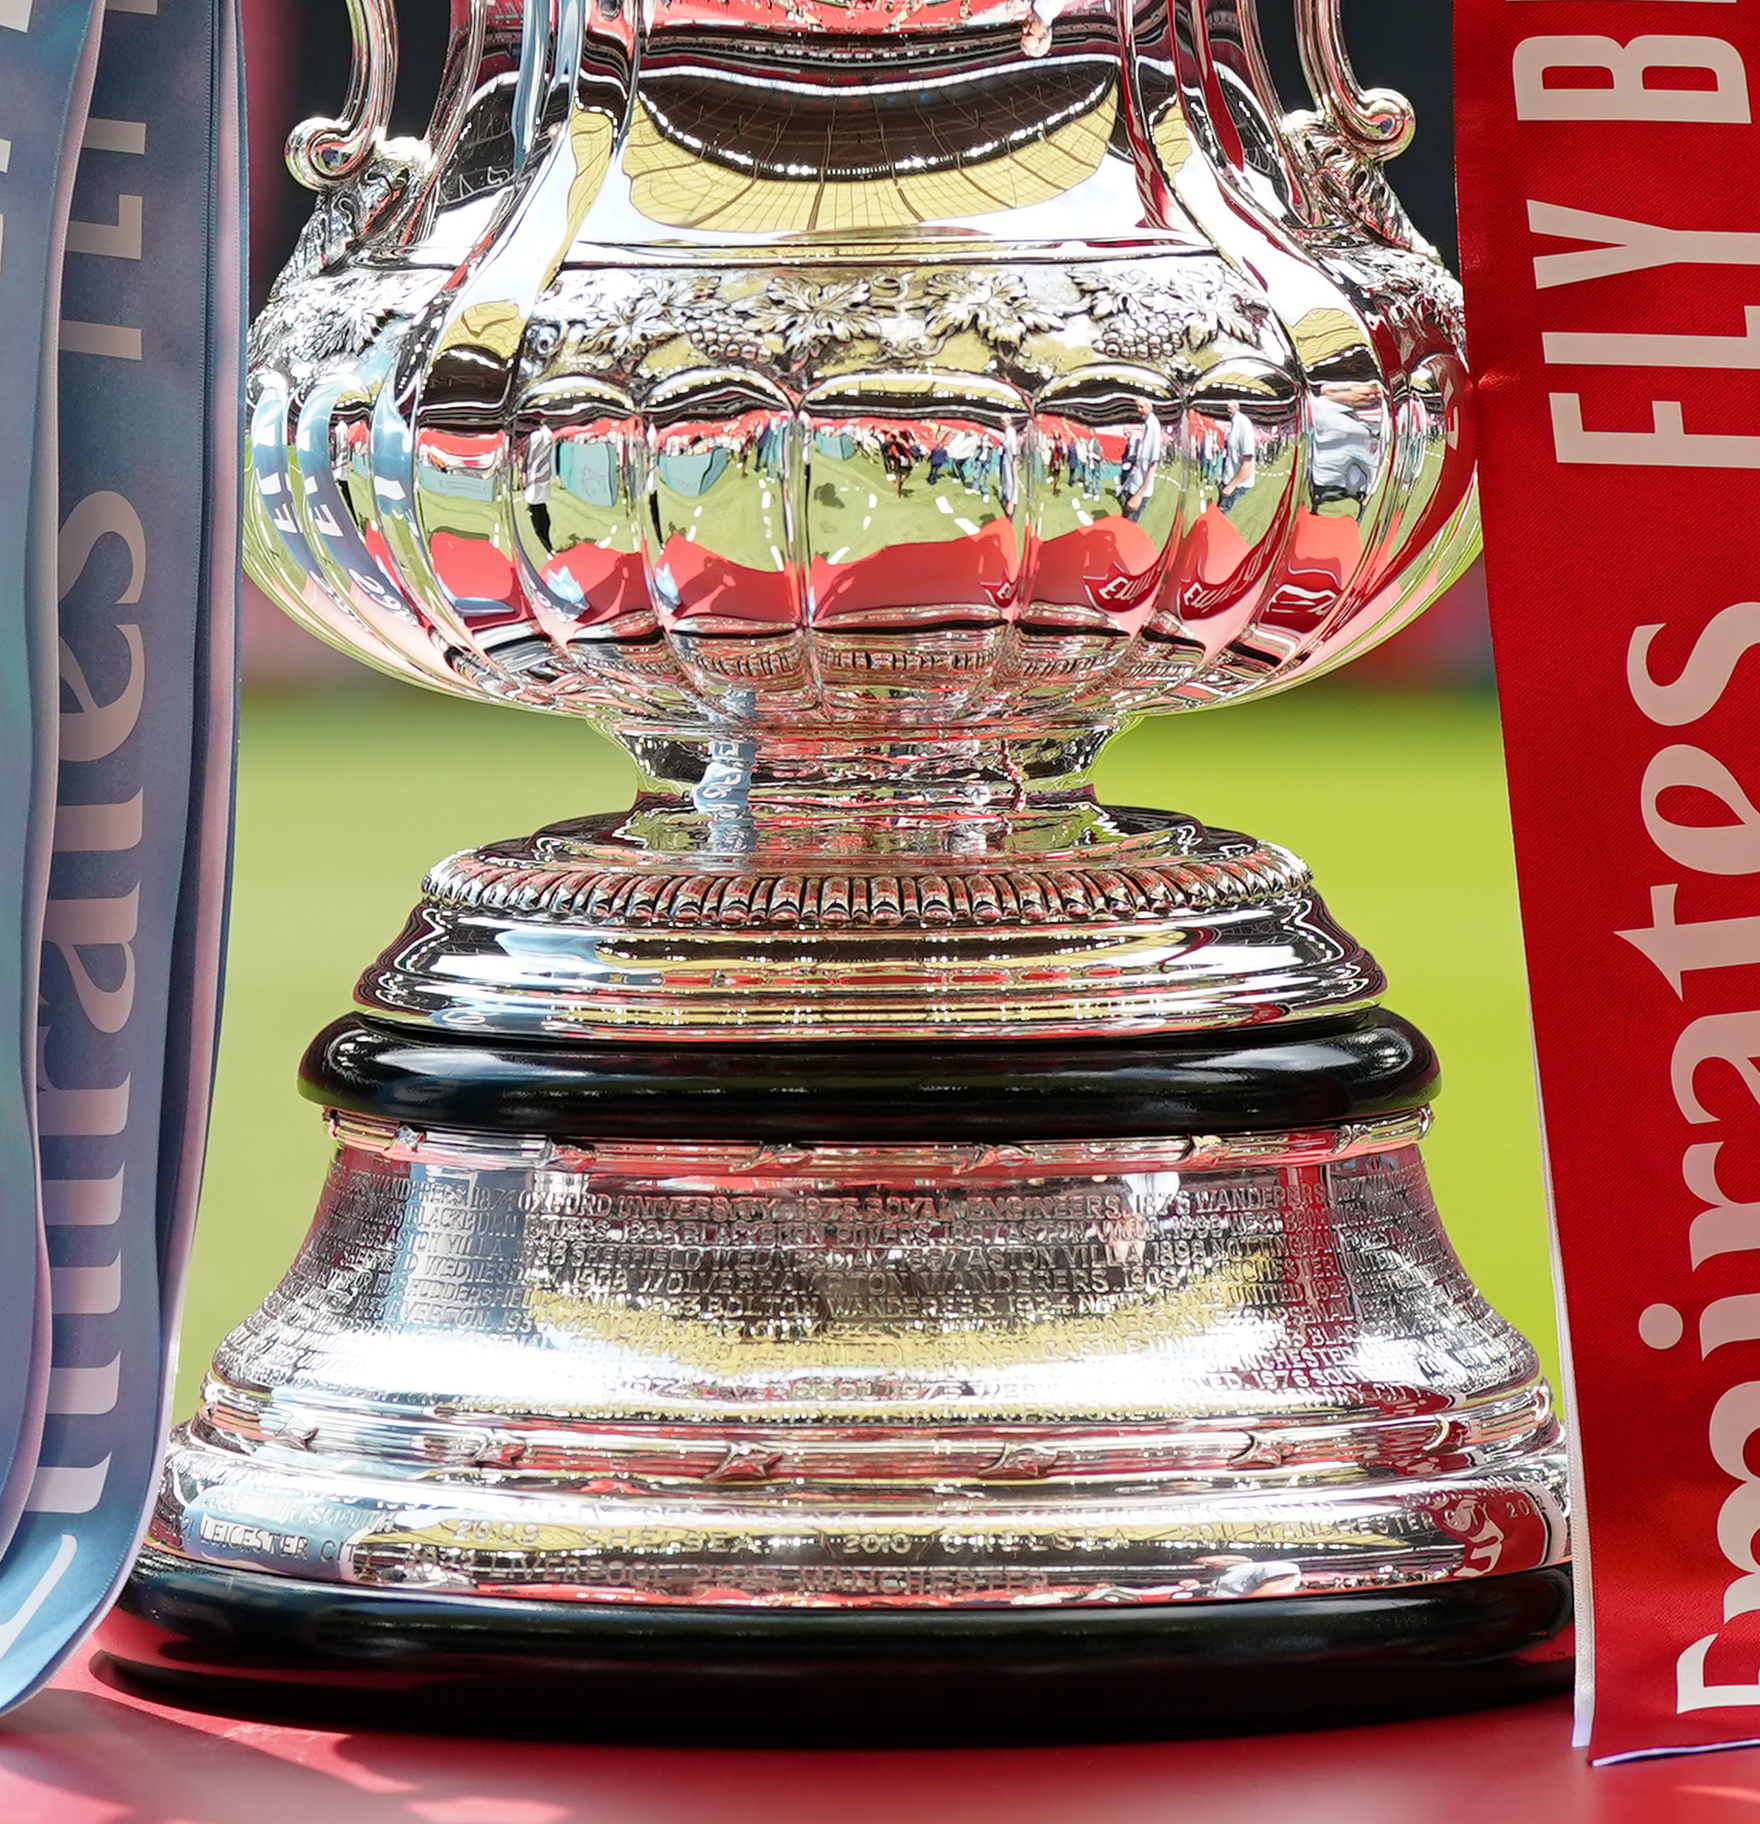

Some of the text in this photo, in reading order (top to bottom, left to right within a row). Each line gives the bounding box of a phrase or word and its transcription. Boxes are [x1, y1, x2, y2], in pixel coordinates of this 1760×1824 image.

[1195, 1182, 1327, 1214] WANDERERS
[965, 1247, 1056, 1271] ASTON
[1226, 1282, 1307, 1308] UNITED
[1252, 1368, 1310, 1390] 1976
[200, 1512, 309, 1563] LEICESTER
[1250, 1509, 1435, 1541] MANCHESTER
